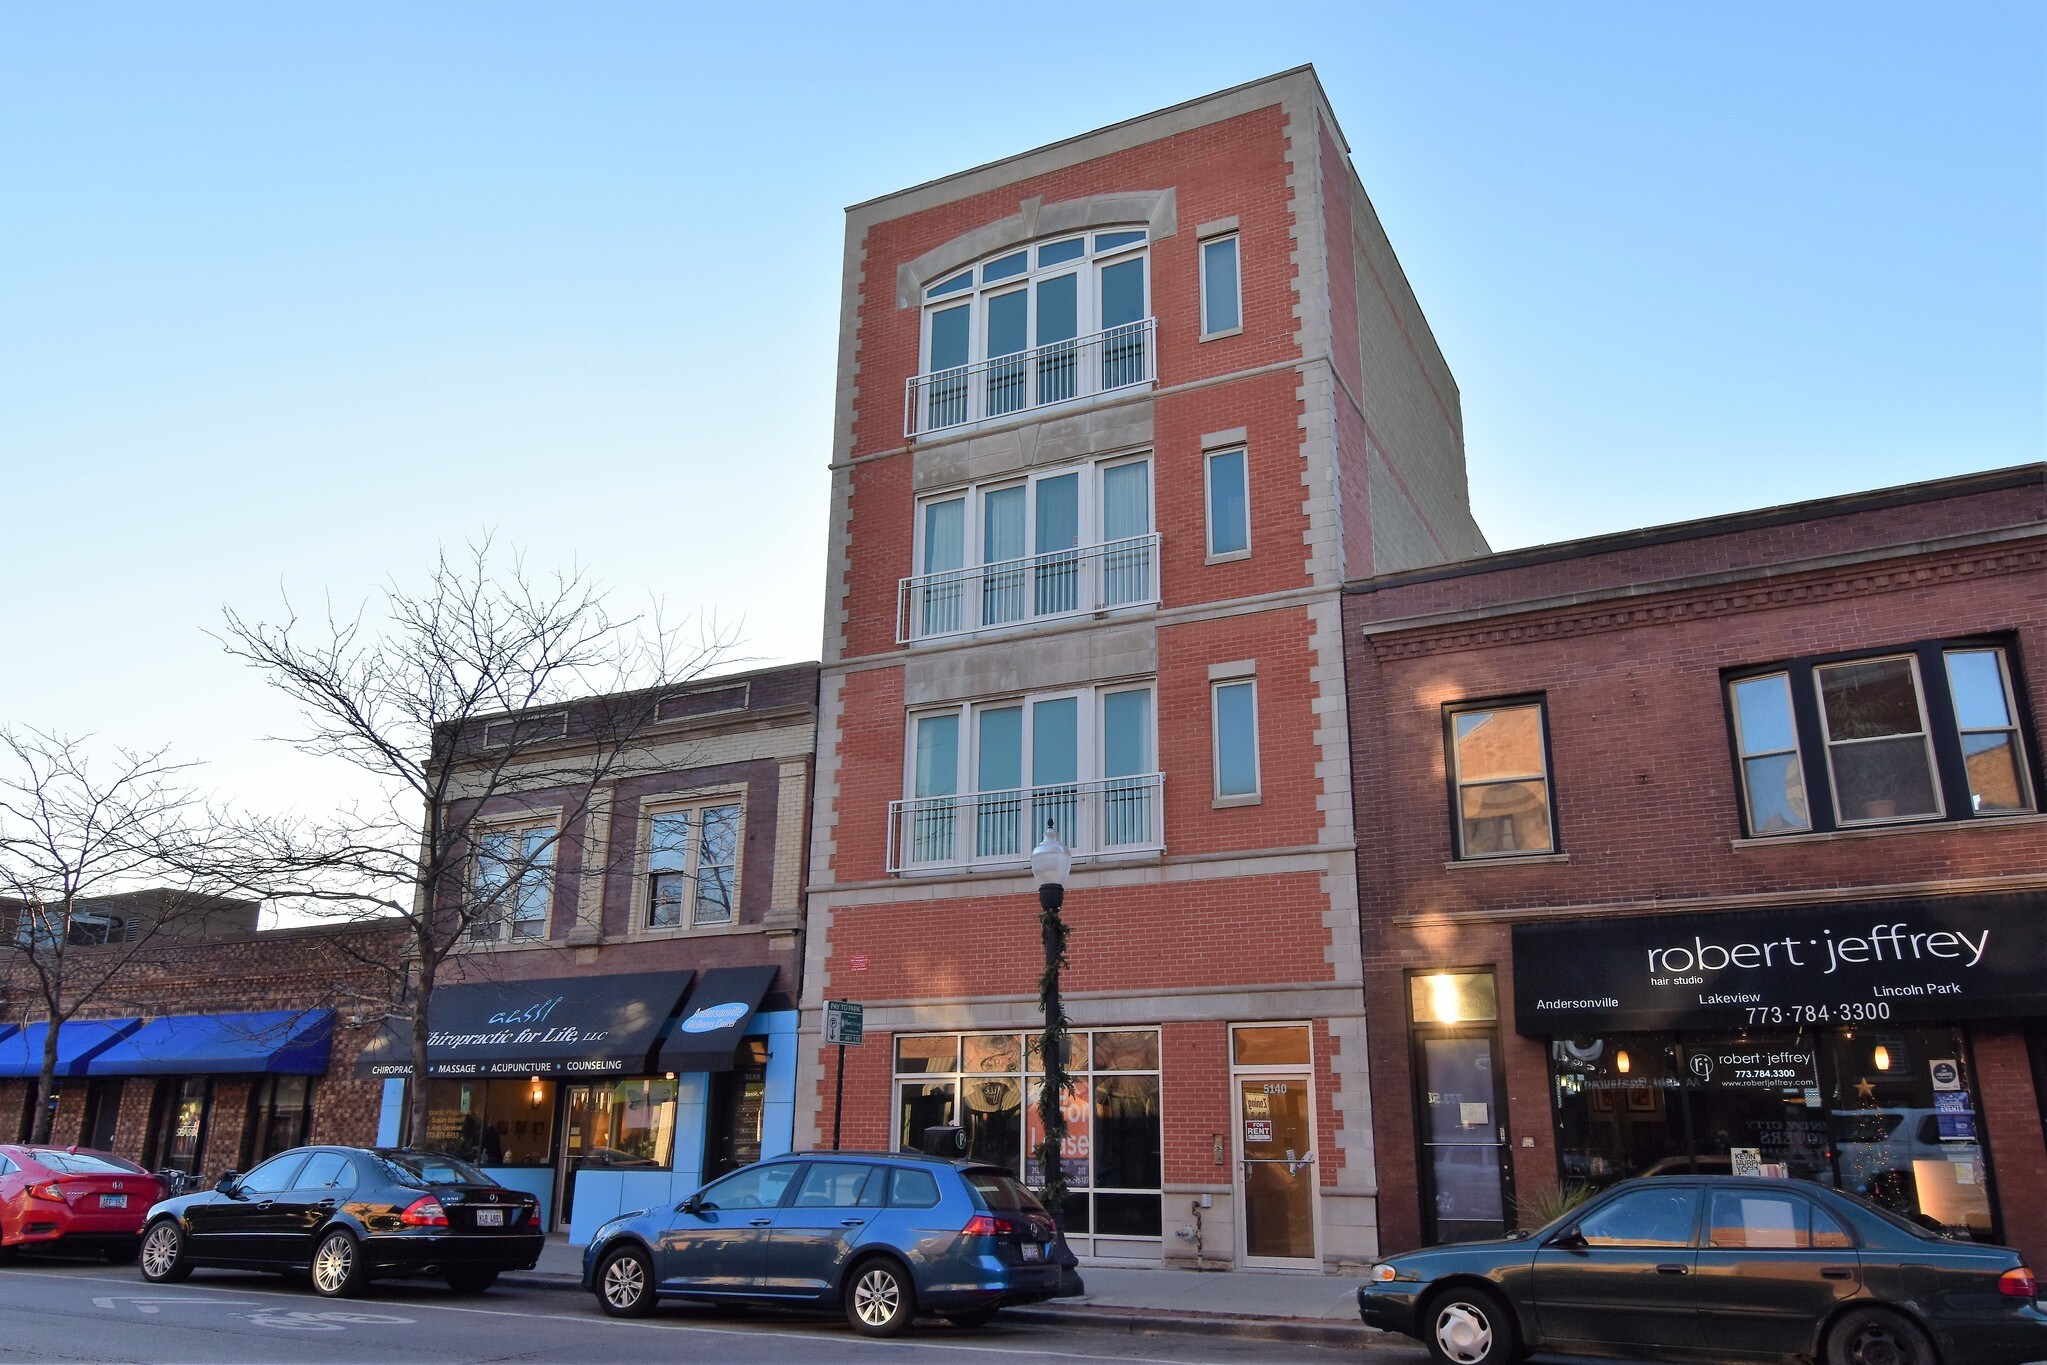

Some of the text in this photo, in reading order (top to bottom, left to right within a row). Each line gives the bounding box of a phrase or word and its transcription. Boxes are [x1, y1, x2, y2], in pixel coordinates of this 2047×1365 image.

[1647, 922, 1990, 974] robert jeffrey
[1650, 975, 1704, 986] hair studio
[1873, 981, 1962, 998] Lincoln Park
[1536, 996, 1619, 1010] Andersonville
[1698, 991, 1761, 1005] Lakeview
[514, 1027, 542, 1044] for
[540, 1025, 580, 1046] Life,
[582, 1031, 609, 1042] LLC
[1718, 1052, 1760, 1065] robert
[1767, 1051, 1811, 1066] jeffrey
[372, 1060, 623, 1075] CHIROPRAC MASSAGE ACUPUNCTURE COUNSELING
[1735, 1069, 1796, 1078] 773.784.3300
[1263, 1083, 1287, 1094] 5140
[1721, 1078, 1814, 1088] www.robertjeffrey.com
[1940, 1104, 1965, 1113] EVENTS
[1247, 1127, 1270, 1135] RENT
[1735, 1153, 1756, 1161] KEVIN
